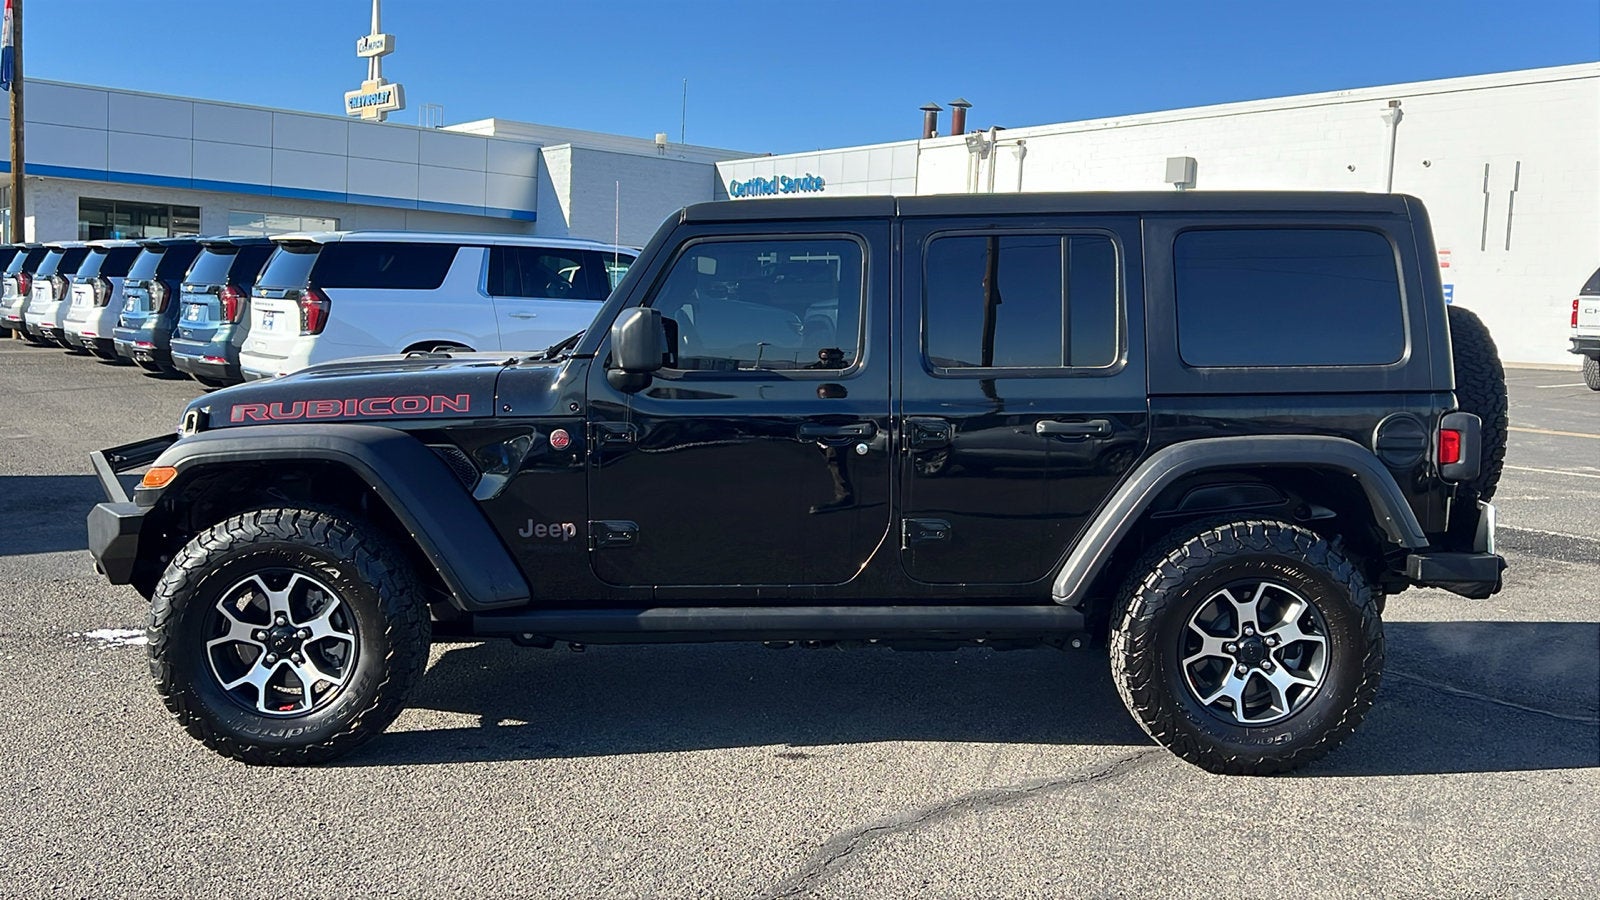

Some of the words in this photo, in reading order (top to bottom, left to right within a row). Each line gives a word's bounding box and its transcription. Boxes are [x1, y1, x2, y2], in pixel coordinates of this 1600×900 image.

[350, 90, 391, 109] CHEVROLET
[730, 175, 779, 198] Certified
[780, 172, 825, 194] Service
[230, 394, 470, 422] RUBICON
[518, 518, 577, 541] Jeep
